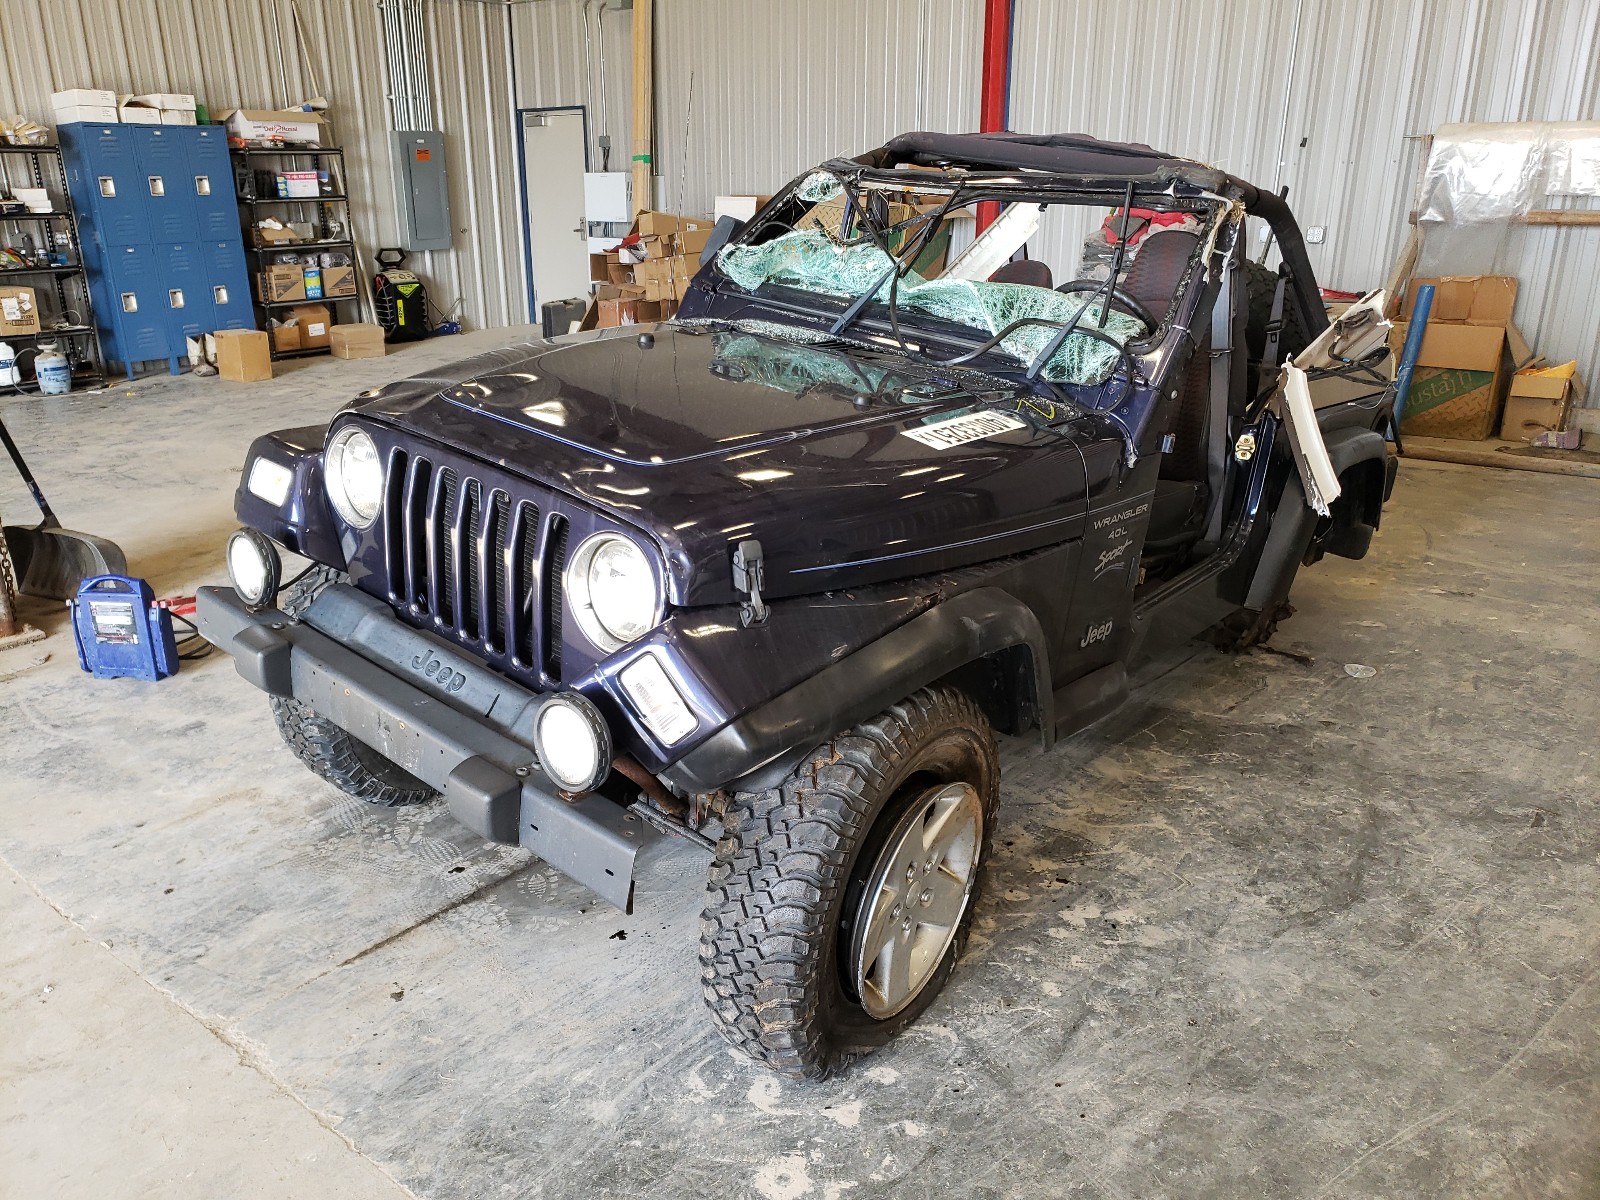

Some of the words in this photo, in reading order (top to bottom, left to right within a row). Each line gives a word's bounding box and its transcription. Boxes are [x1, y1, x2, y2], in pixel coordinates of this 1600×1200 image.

[924, 417, 1012, 445] 40033251
[1093, 503, 1149, 530] WRANGLER
[1080, 620, 1113, 648] Jeep
[411, 649, 467, 692] Jeep
